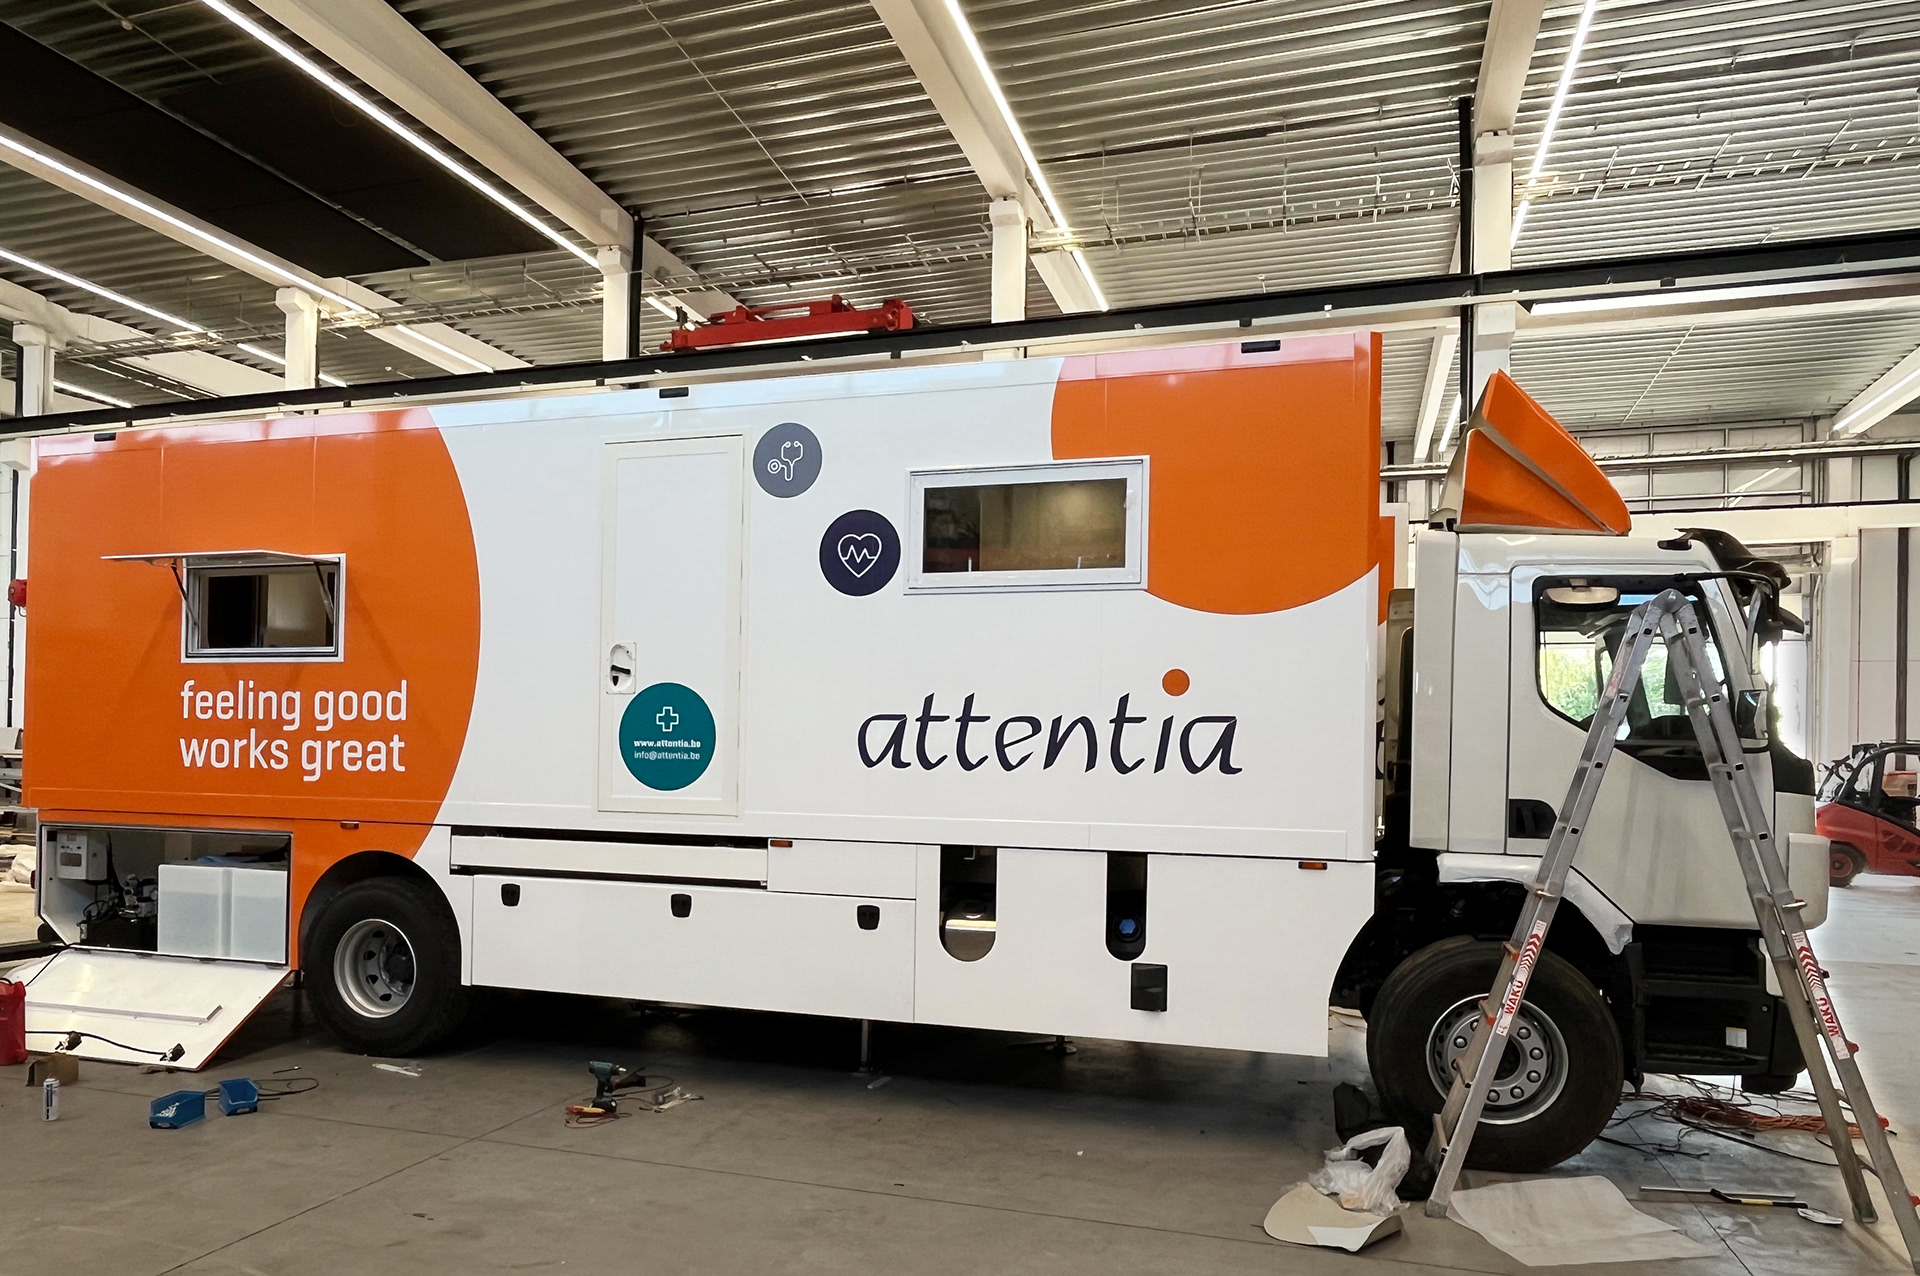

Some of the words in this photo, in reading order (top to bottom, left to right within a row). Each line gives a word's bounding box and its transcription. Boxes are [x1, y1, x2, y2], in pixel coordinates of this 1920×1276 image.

[180, 680, 300, 731] feeling
[313, 679, 407, 731] good
[857, 668, 1243, 775] attentia
[179, 728, 288, 770] works
[301, 734, 407, 782] great
[633, 739, 701, 748] www.attentia.be
[634, 750, 701, 760] info@attentia.be
[1504, 980, 1524, 1015] WAKU
[1816, 997, 1840, 1037] WAKU
